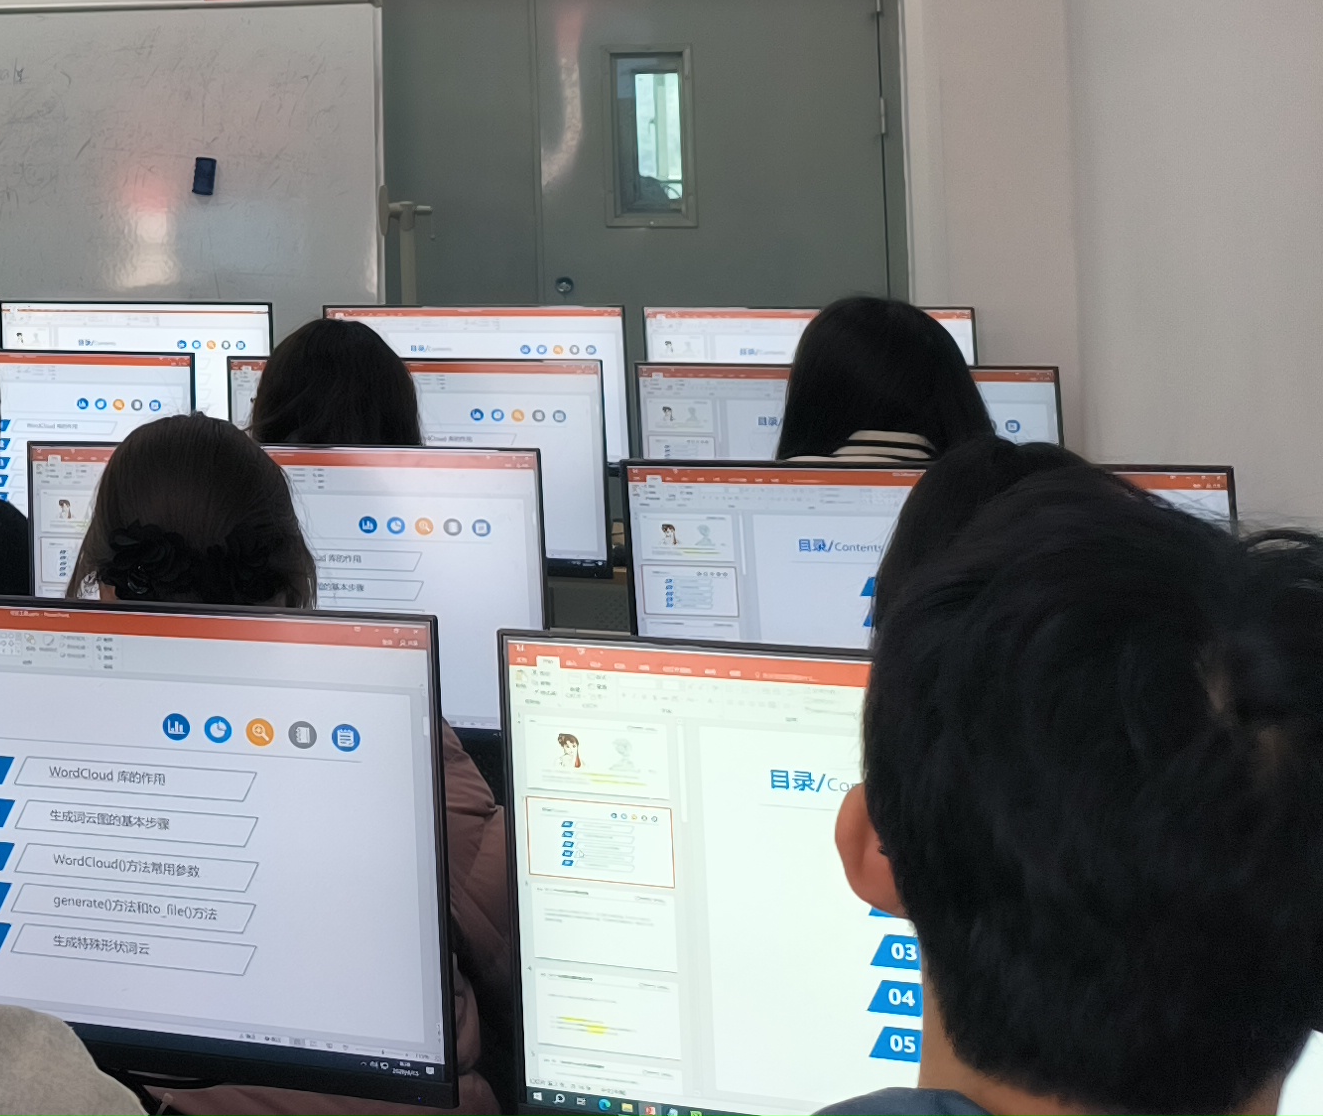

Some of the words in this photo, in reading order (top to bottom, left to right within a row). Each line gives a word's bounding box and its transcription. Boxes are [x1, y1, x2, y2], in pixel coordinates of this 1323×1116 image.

[49, 765, 114, 783] WordCloud
[117, 770, 166, 786] 库的作用
[49, 809, 171, 831] 生成词云图的基本步骤
[53, 853, 201, 879] WordCloud()方法常用参数
[53, 896, 218, 921] generate()方法和to_file()方法
[52, 934, 151, 956] 生成特殊形状词云
[890, 942, 918, 962] 03
[887, 988, 916, 1007] 04
[889, 1034, 917, 1054] 05
